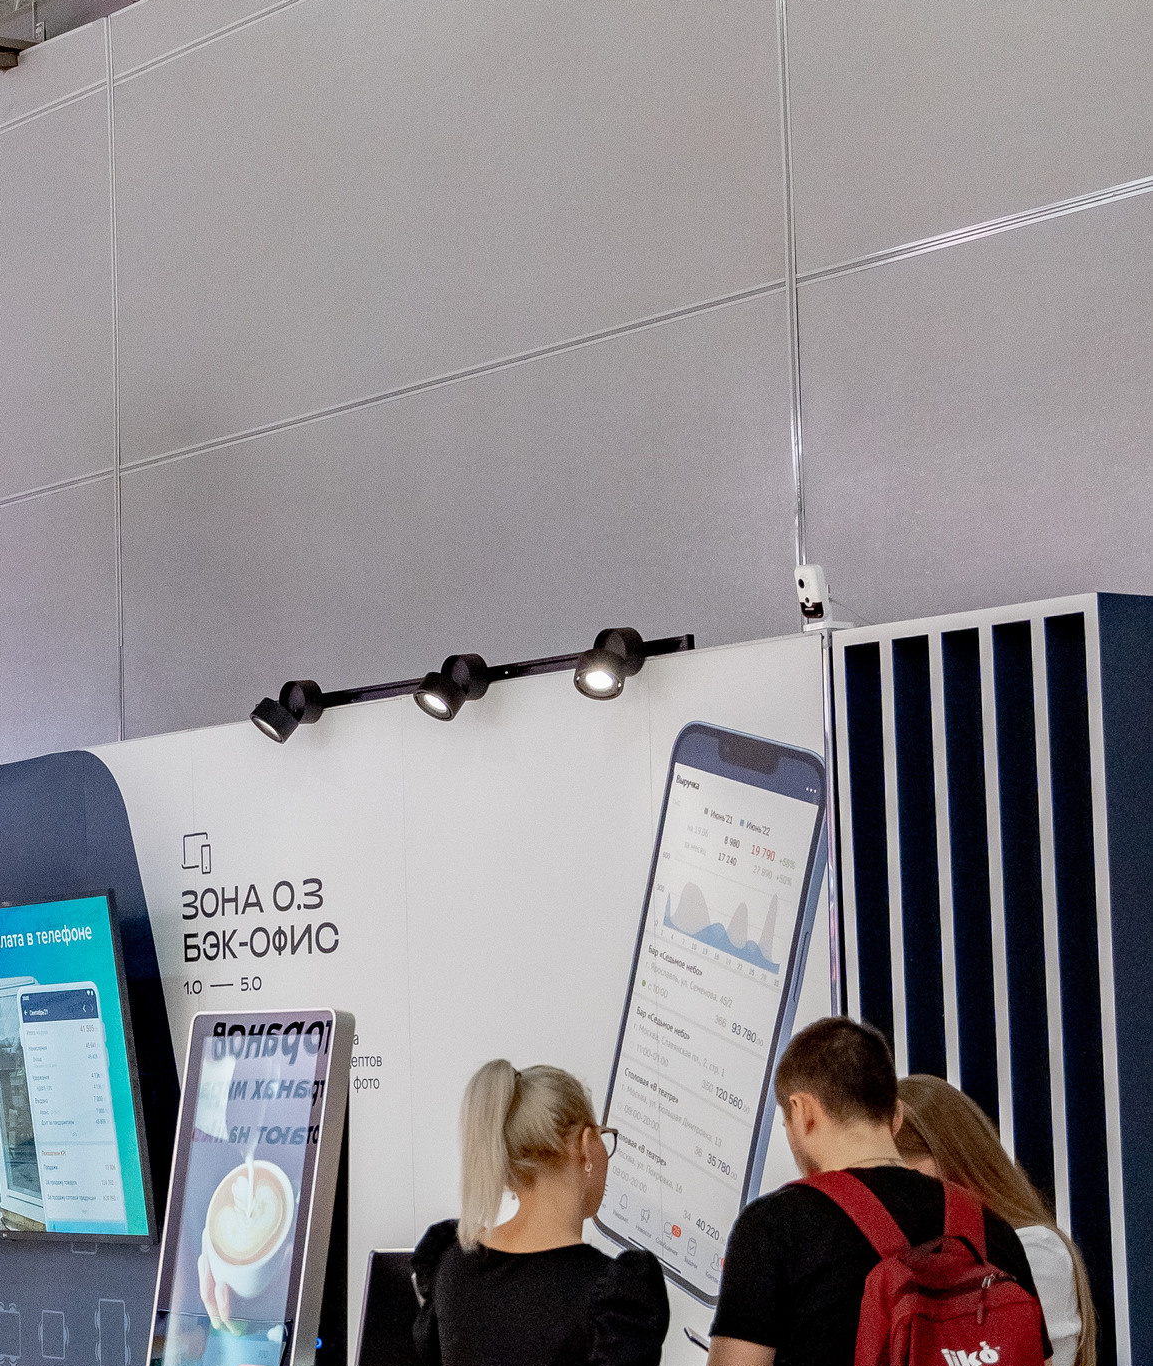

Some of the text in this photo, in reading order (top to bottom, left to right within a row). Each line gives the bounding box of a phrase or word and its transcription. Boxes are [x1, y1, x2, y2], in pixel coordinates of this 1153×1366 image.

[675, 774, 700, 790] Выручка
[718, 852, 725, 861] 17
[725, 855, 737, 866] 240
[729, 838, 741, 849] 980
[751, 844, 761, 856] 19
[761, 847, 776, 862] 790
[182, 878, 324, 920] ЗОНА 0.3
[27, 933, 33, 946] в
[36, 924, 93, 946] телефоне
[184, 922, 340, 963] БЭК-ОФИС
[648, 944, 703, 976] Бар «Седьмое небо»
[183, 980, 203, 995] 1.0
[240, 976, 262, 991] 5.0
[637, 1006, 690, 1040] Бар «Седьмое небо»
[731, 1023, 741, 1035] 93
[353, 1076, 380, 1093] фото
[625, 1067, 649, 1087] Столовая
[658, 1087, 679, 1103] театре»
[715, 1087, 728, 1101] 120
[647, 1149, 667, 1167] театре»
[707, 1153, 717, 1167] 35
[695, 1218, 706, 1231] 40
